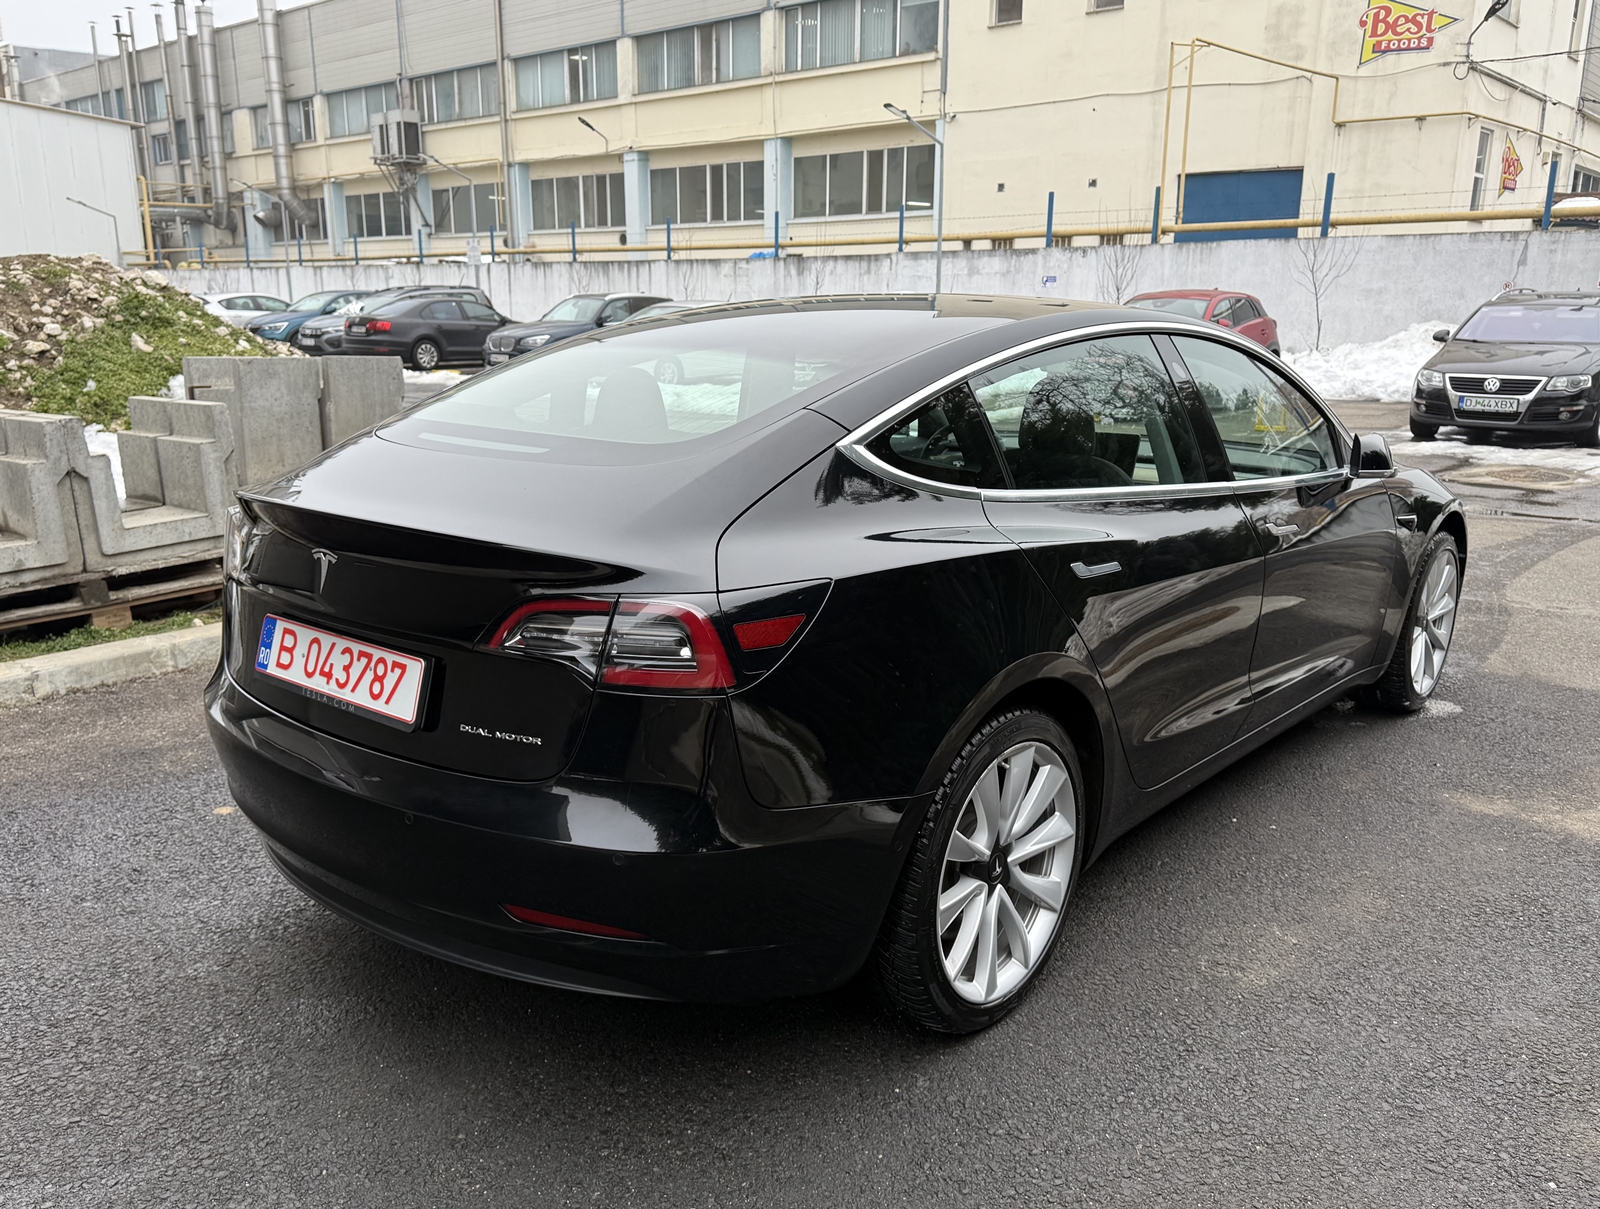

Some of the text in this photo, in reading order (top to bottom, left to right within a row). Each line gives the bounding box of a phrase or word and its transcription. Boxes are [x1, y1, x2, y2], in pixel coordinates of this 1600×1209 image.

[1359, 5, 1438, 38] Best
[1381, 38, 1428, 49] FOODS
[1502, 146, 1520, 177] Best
[1464, 398, 1478, 407] DJ
[1480, 399, 1492, 408] 44
[1493, 400, 1515, 409] XBX
[258, 646, 271, 665] RO
[275, 627, 408, 706] B 043787
[301, 687, 355, 713] TESLA.COM
[460, 724, 542, 745] DUAL MOTOR
